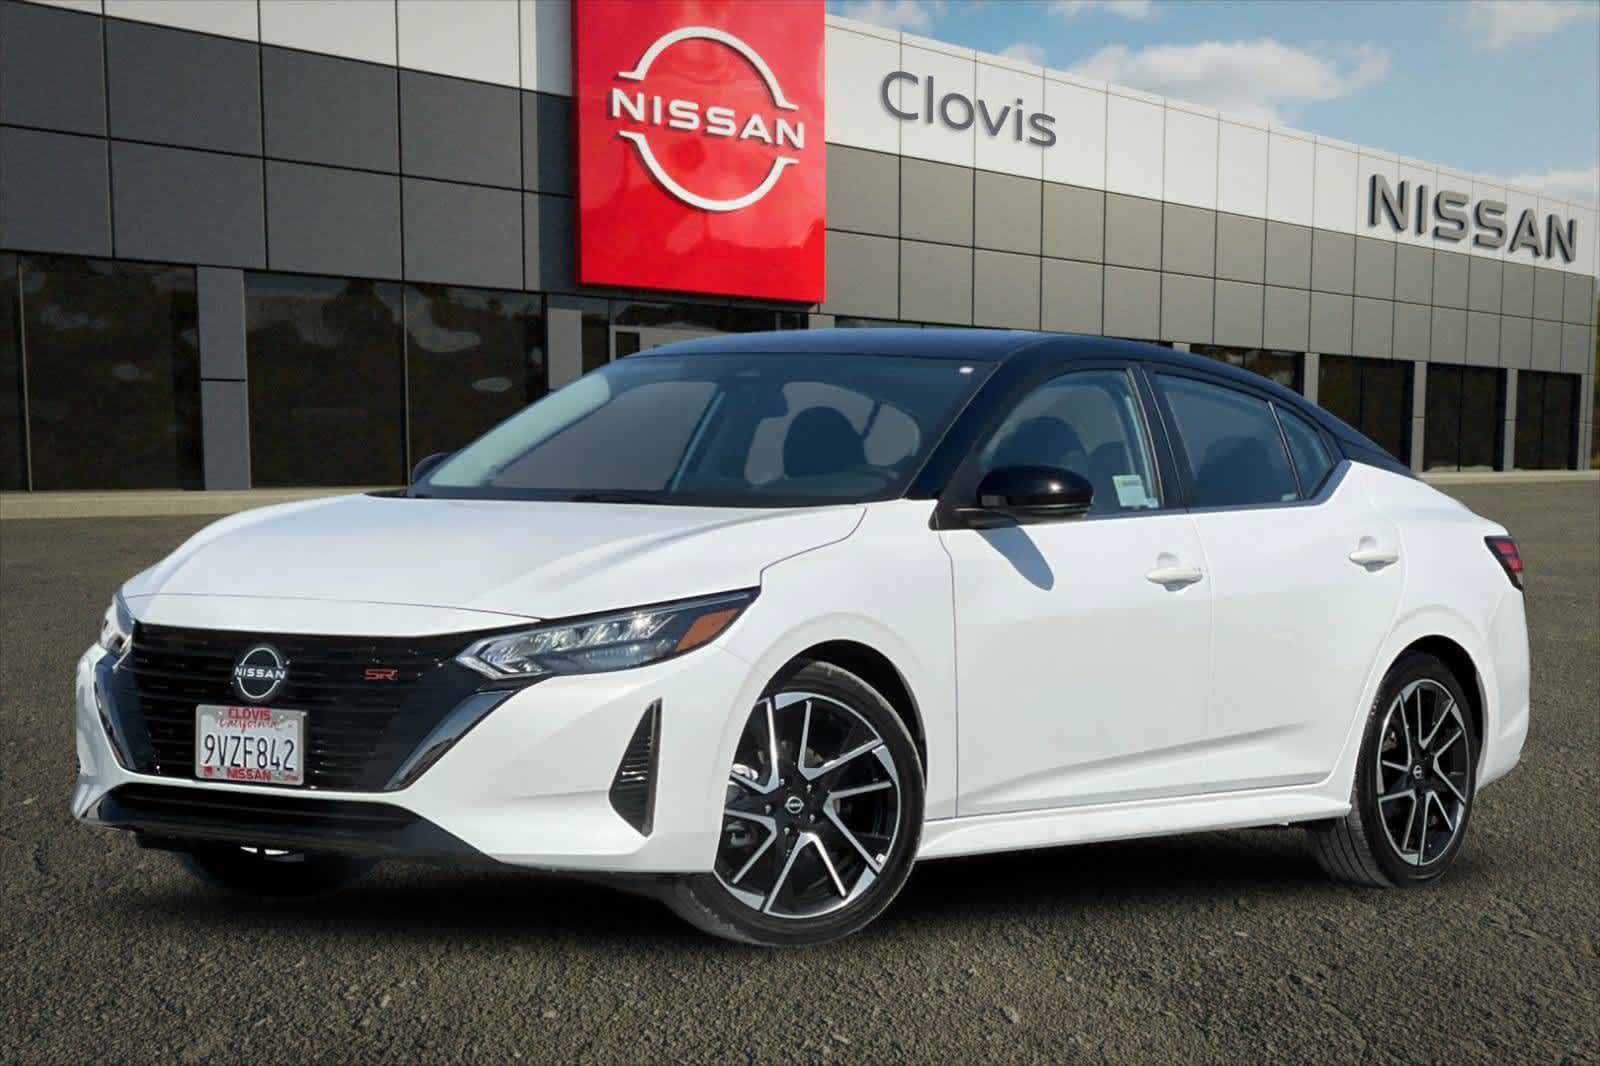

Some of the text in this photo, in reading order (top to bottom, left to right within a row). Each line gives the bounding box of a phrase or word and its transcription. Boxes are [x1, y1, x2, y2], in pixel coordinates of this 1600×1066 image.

[612, 87, 805, 149] NISSAN
[882, 70, 1057, 147] Clovis
[1368, 173, 1578, 264] NISSAN
[234, 666, 286, 680] NISSAN
[363, 668, 399, 681] SR
[227, 706, 272, 721] CLOVIS
[204, 734, 295, 772] 9VZF842
[226, 767, 273, 781] NISSAN
